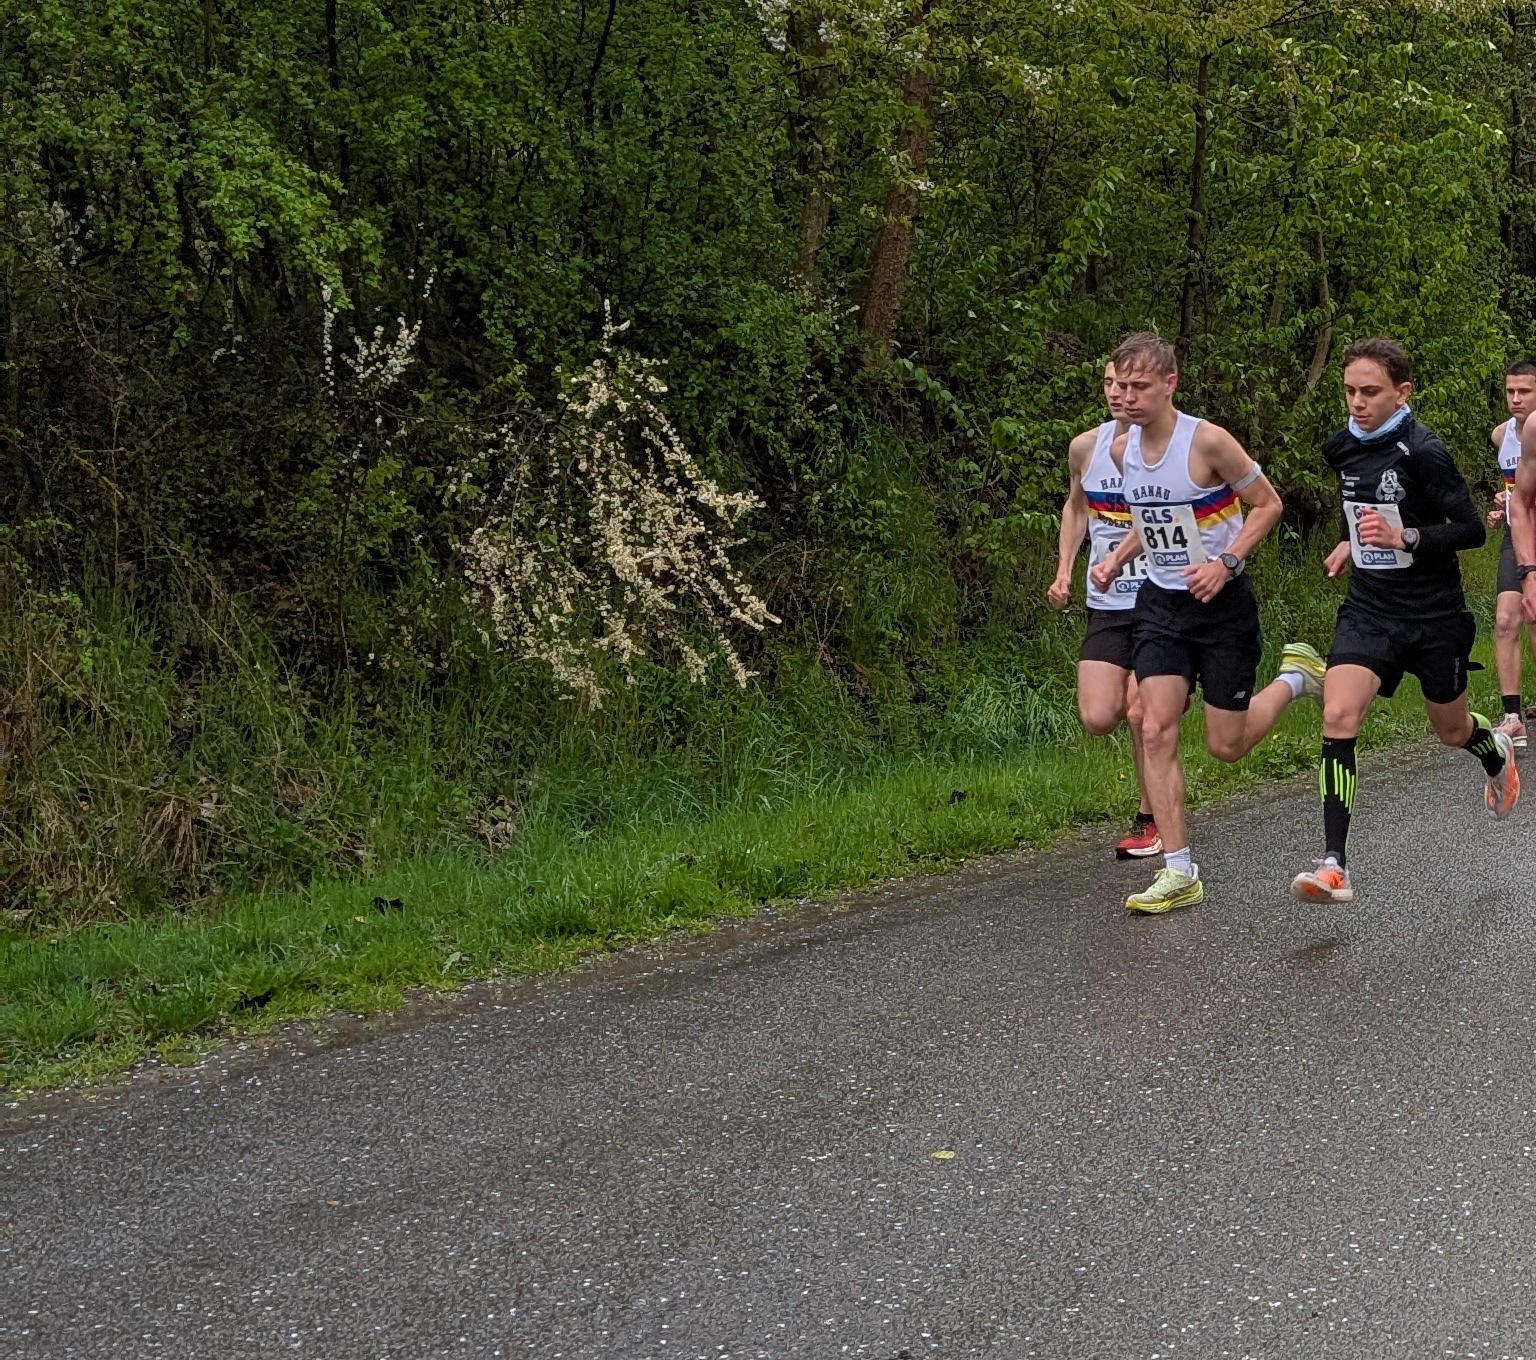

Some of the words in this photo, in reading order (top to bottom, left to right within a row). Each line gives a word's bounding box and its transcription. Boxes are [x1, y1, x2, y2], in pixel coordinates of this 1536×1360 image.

[1132, 485, 1171, 501] HANAU
[1143, 525, 1189, 550] 814
[1165, 552, 1189, 562] PLAN
[1374, 552, 1395, 561] PLAN
